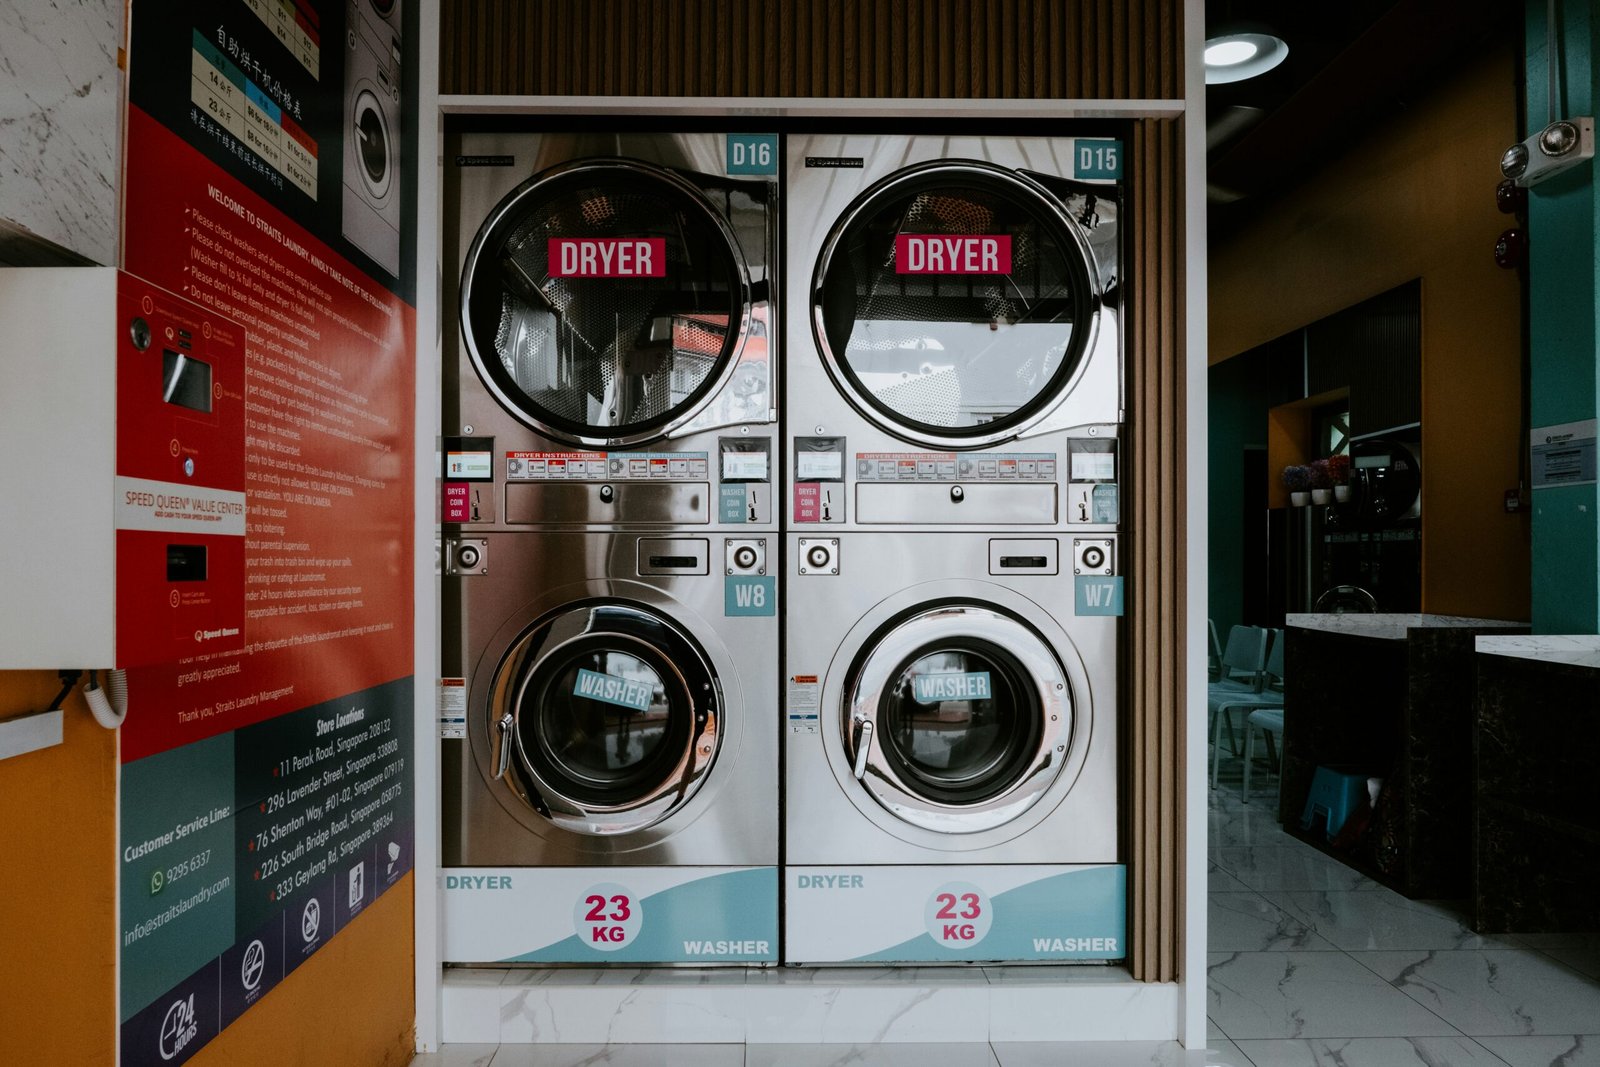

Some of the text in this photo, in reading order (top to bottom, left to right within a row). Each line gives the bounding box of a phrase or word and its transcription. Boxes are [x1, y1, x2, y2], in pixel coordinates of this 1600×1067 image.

[210, 72, 218, 85] 14
[209, 98, 218, 112] 23
[733, 142, 771, 166] D16
[1081, 148, 1117, 170] D15
[192, 207, 213, 232] Please
[215, 224, 232, 243] check
[233, 236, 257, 258] washers
[257, 251, 268, 265] and
[269, 255, 285, 275] dryers
[286, 268, 294, 280] are
[294, 274, 309, 291] empty
[309, 280, 323, 298] before
[208, 182, 245, 220] WELCOME
[246, 208, 255, 227] TO
[256, 215, 281, 244] STRAITS
[311, 253, 328, 275] KINDLY
[329, 265, 341, 284] TAKE
[342, 274, 353, 292] NOTE
[353, 282, 359, 296] OF
[908, 239, 998, 271] DRYER
[191, 226, 213, 250] Please
[215, 239, 222, 255] do
[224, 248, 234, 262] not
[236, 254, 260, 277] overload
[261, 266, 270, 282] the
[296, 287, 306, 304] they
[561, 242, 652, 275] DRYER
[190, 244, 218, 271] (Washer
[219, 260, 227, 276] fill
[228, 265, 235, 280] to
[242, 273, 251, 289] full
[252, 282, 264, 297] only
[265, 289, 275, 302] and
[276, 292, 289, 309] dryer
[190, 284, 200, 300] Do
[202, 292, 213, 306] not
[215, 296, 231, 314] leave
[232, 307, 256, 326] personal
[257, 319, 280, 339] property
[191, 264, 212, 287] Please
[214, 276, 230, 296] don't
[232, 285, 246, 304] leave
[248, 294, 263, 312] items
[263, 302, 269, 316] in
[270, 309, 293, 328] machines
[126, 491, 154, 506] SPEED
[192, 500, 215, 512] VALUE
[217, 502, 243, 515] CENTER
[251, 505, 260, 515] will
[261, 506, 268, 516] be
[248, 573, 270, 584] drinking
[736, 584, 765, 607] W8
[1085, 584, 1114, 607] W7
[177, 661, 240, 687] greatly appreciated.
[580, 672, 650, 707] WASHER
[920, 677, 987, 698] WASHER
[177, 684, 293, 724] Thank you, Straits Laundry Management
[316, 703, 364, 737] Store Locations
[280, 717, 390, 778] 11 Perak Road, Singapore 208132
[267, 737, 397, 814] 296 Lavender Street, Singapore 338808
[256, 828, 268, 853] 76
[270, 809, 304, 843] Shenton
[305, 799, 323, 827] Way,
[354, 769, 383, 799] Singapore
[124, 806, 230, 862] Customer Service Line:
[261, 781, 401, 881] 226 South Bridge Road, Singapore 058775
[167, 850, 210, 884] 9295 6337
[276, 809, 393, 902] 333 Geylang Rd, Singapore 389364
[446, 876, 512, 889] DRYER
[798, 875, 864, 888] DRYER
[125, 876, 230, 946] info@straitslaundry.com
[585, 895, 631, 921] 23
[936, 893, 981, 919] 23
[592, 926, 625, 942] KG
[684, 941, 769, 954] WASHER
[943, 924, 975, 940] KG
[1034, 938, 1117, 952] WASHER
[176, 993, 194, 1038] 24
[174, 1020, 197, 1056] HOURS
